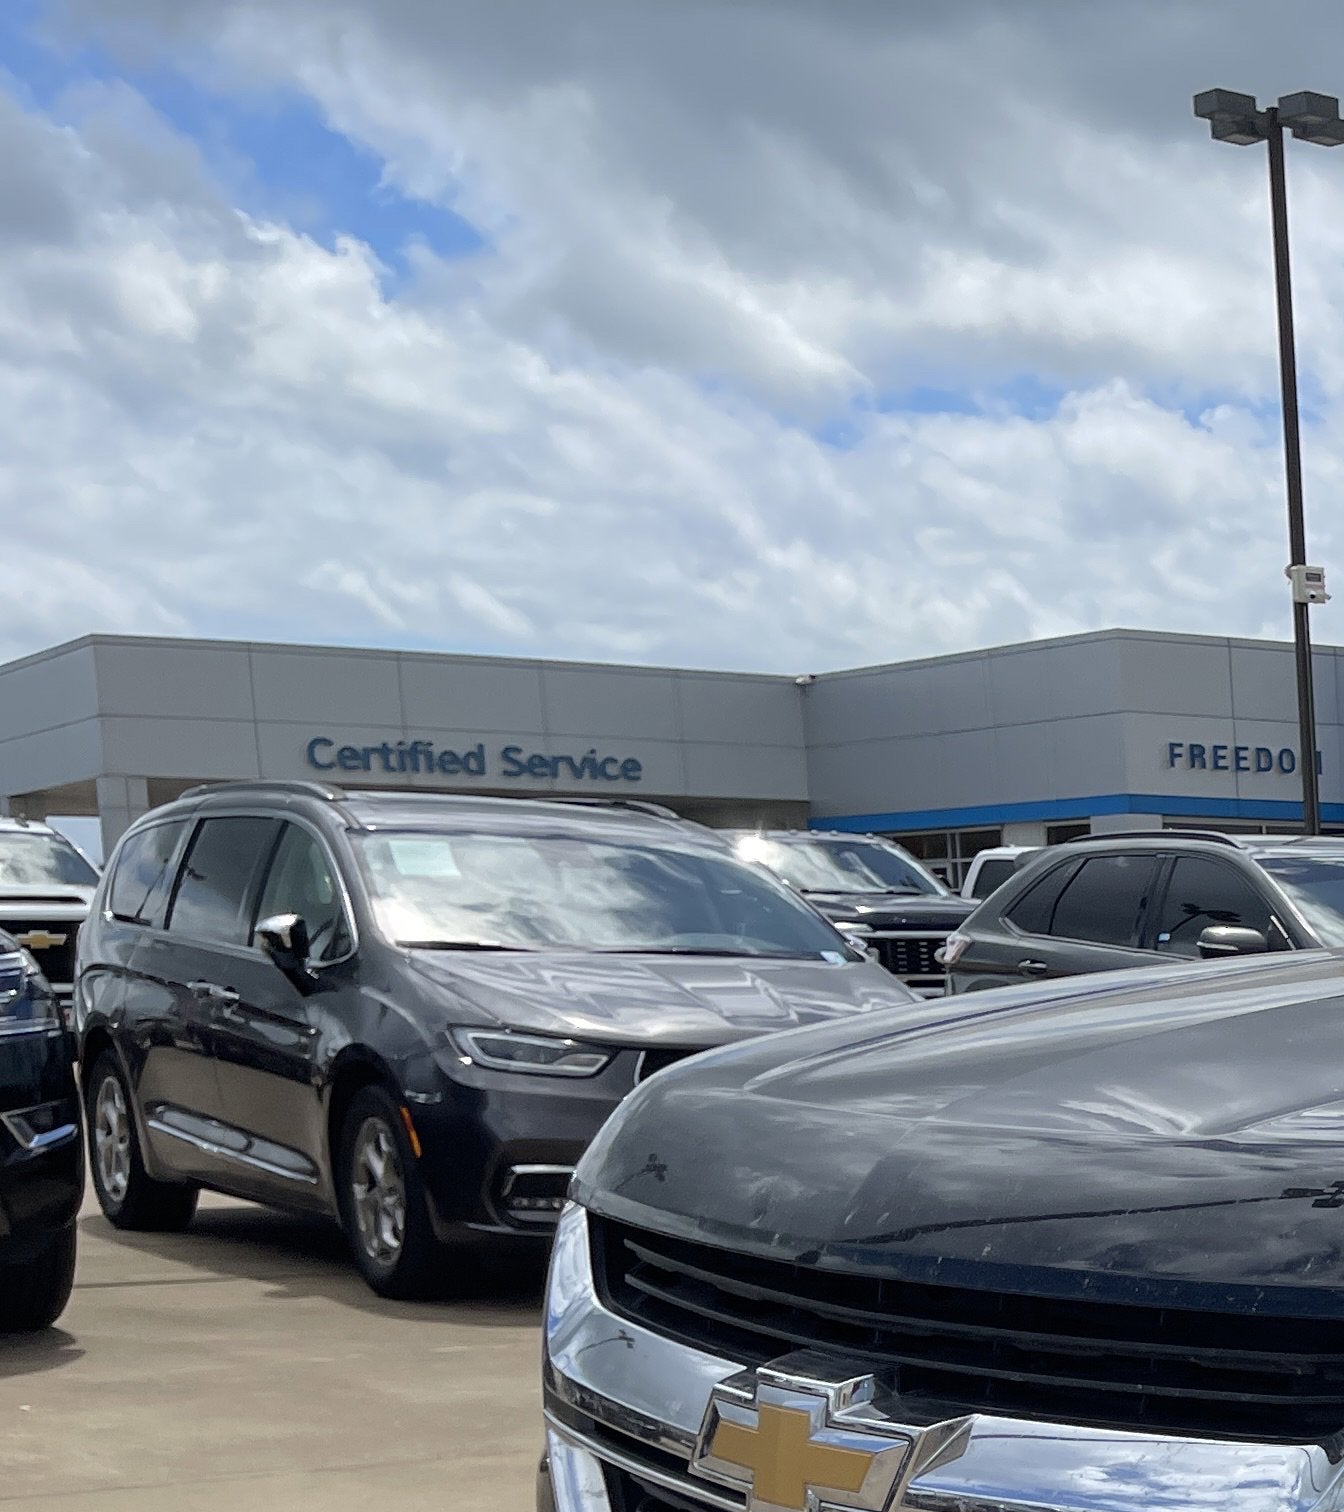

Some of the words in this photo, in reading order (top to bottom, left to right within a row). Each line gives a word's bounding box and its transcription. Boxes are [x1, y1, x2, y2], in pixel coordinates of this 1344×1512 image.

[307, 737, 486, 776] Certified
[502, 745, 642, 781] Service
[1167, 742, 1323, 776] FREEDO
